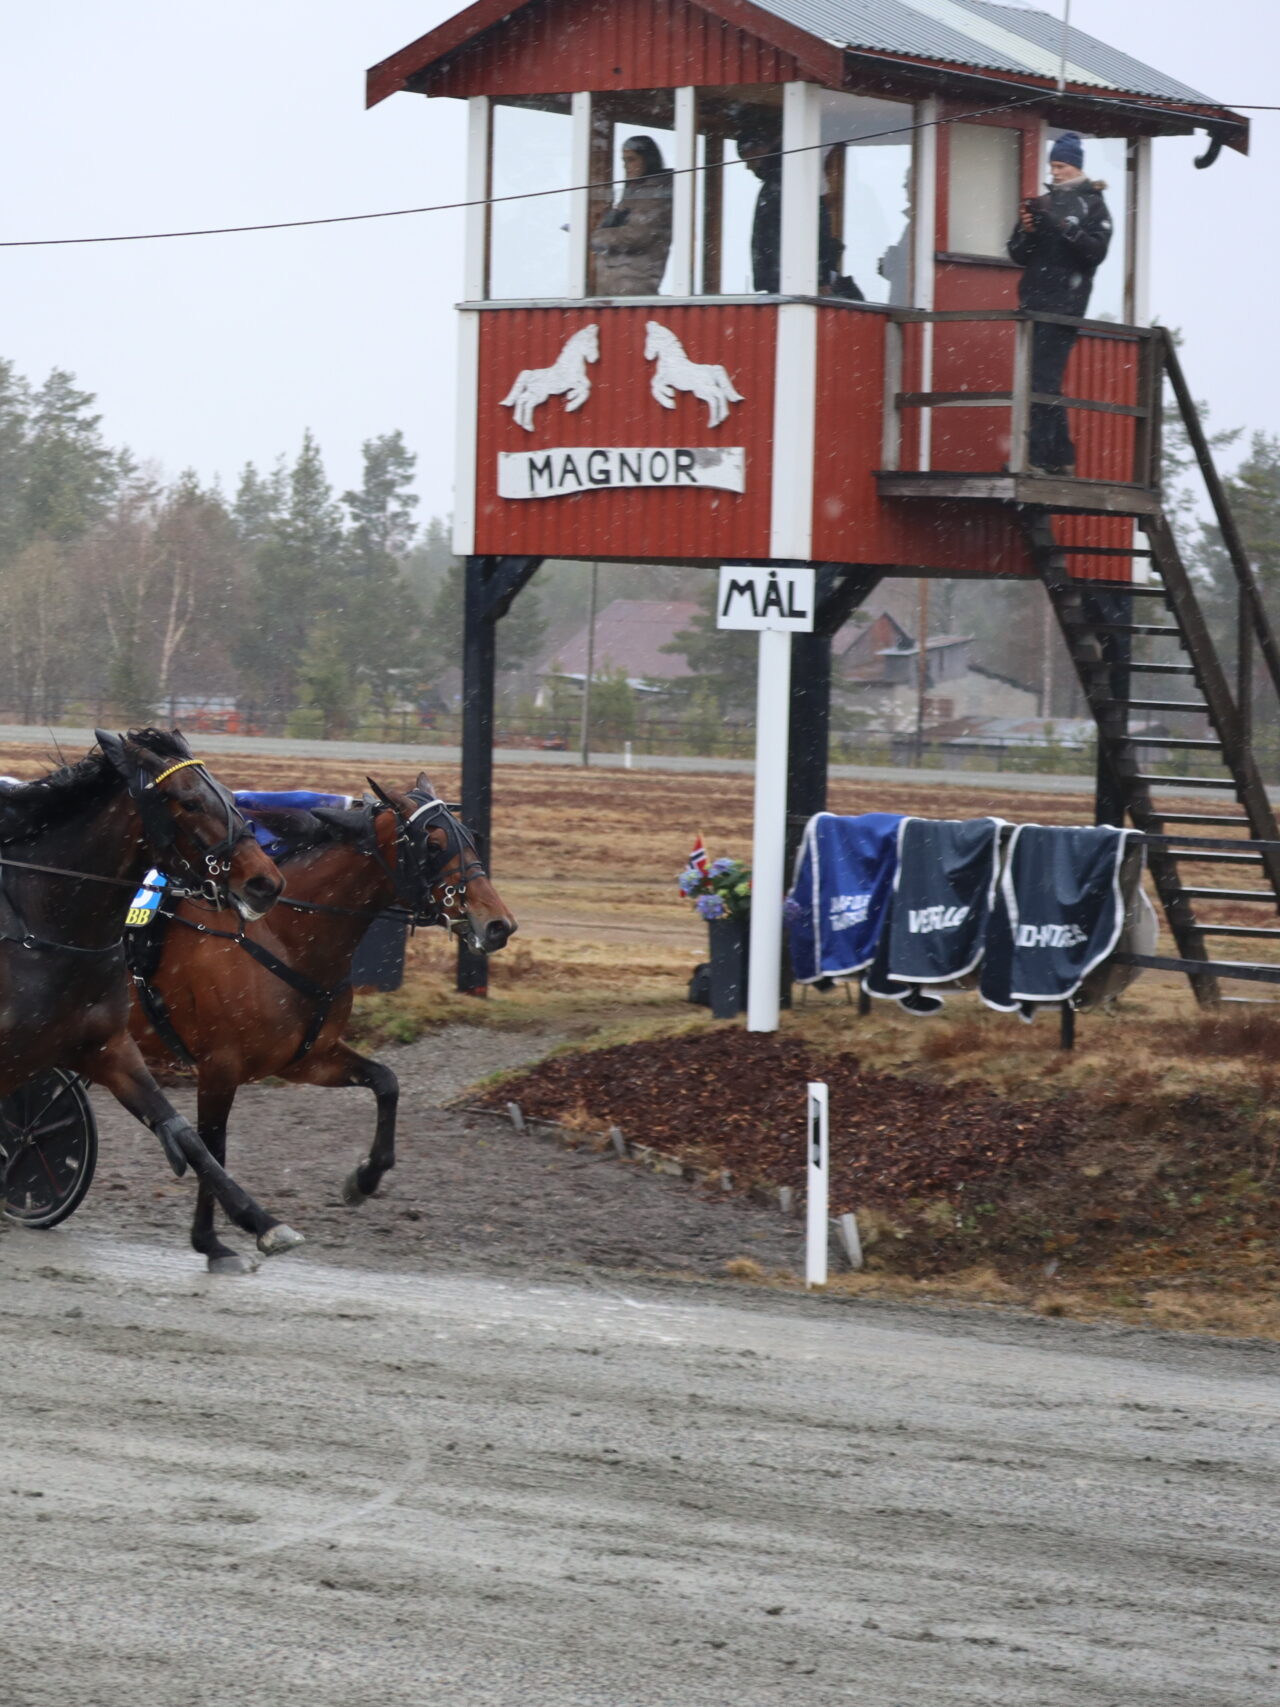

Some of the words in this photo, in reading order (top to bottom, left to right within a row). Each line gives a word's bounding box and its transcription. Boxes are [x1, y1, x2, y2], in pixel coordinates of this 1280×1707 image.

[529, 450, 698, 491] MAGNOR
[722, 570, 807, 618] MÅL
[125, 908, 150, 925] BB
